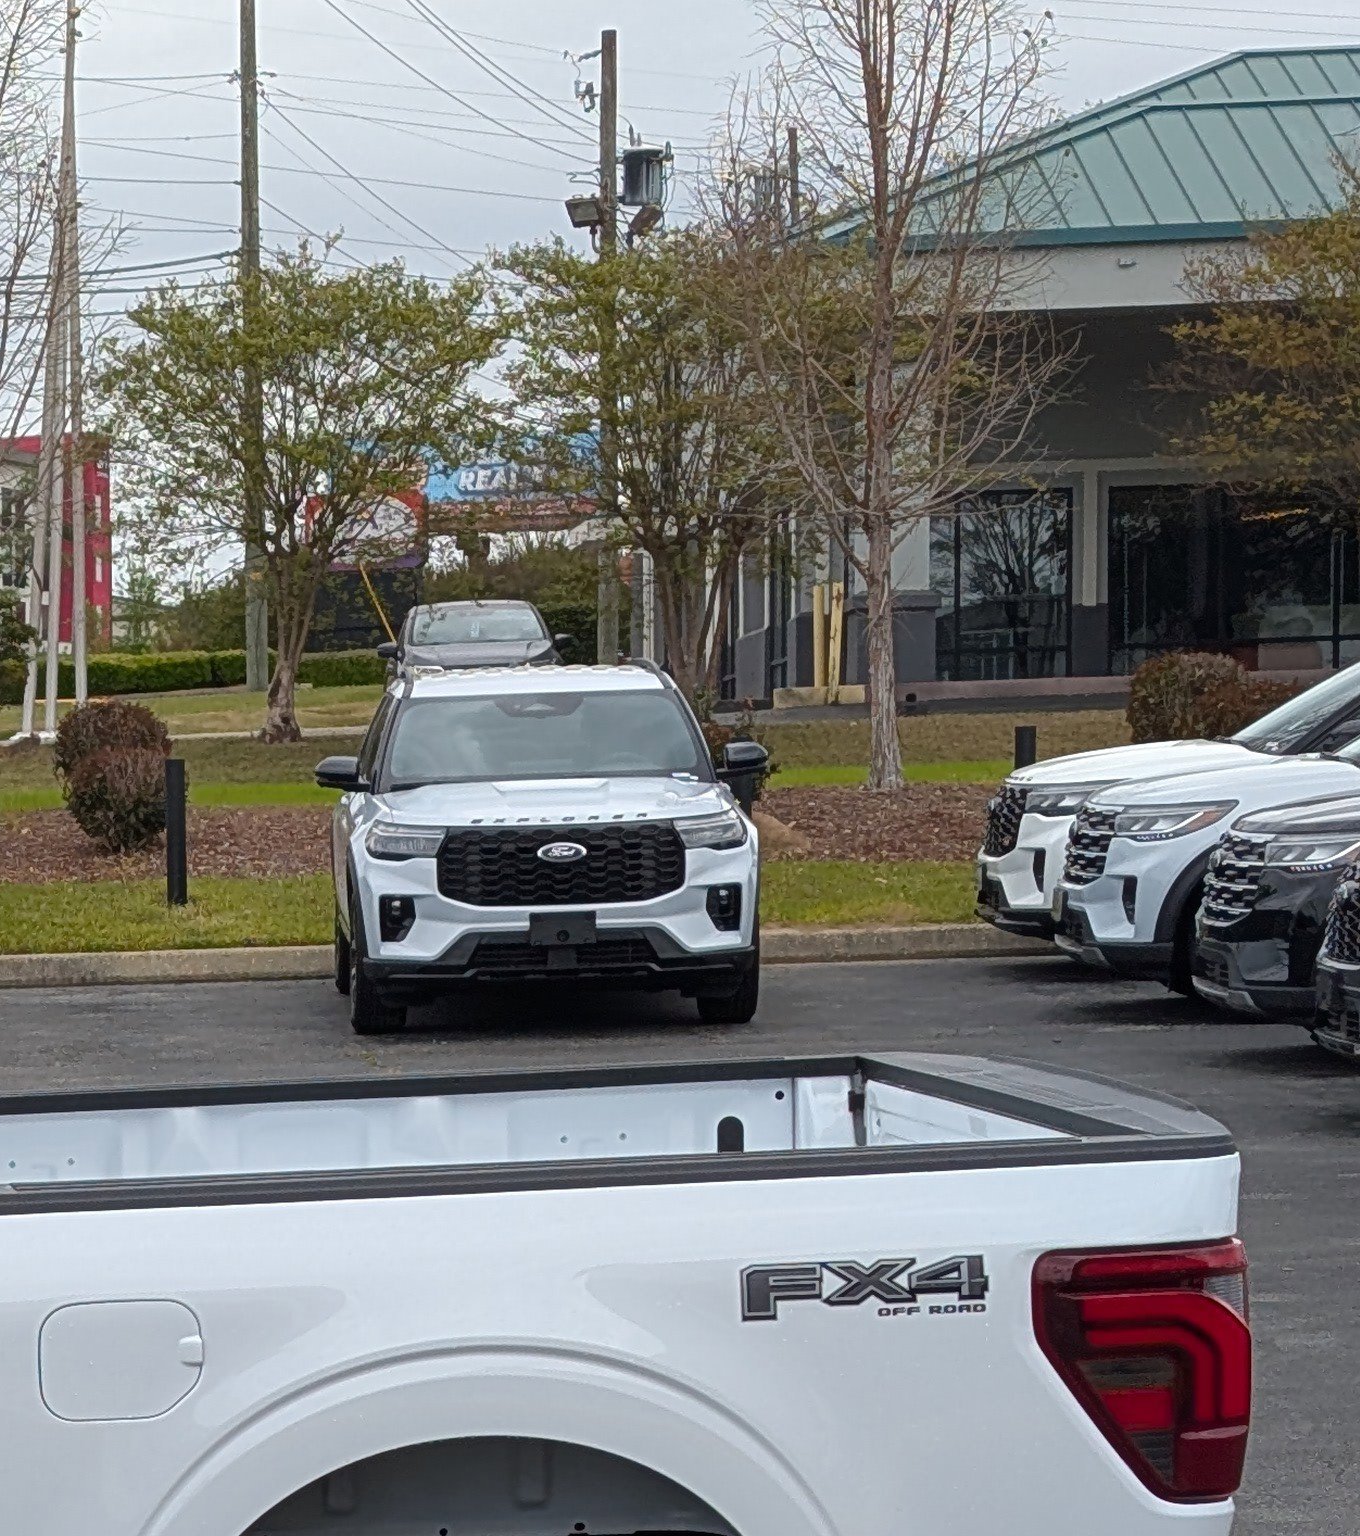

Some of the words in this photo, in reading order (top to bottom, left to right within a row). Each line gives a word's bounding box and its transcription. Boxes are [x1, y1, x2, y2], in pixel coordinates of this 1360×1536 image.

[739, 1254, 989, 1322] FX4
[877, 1305, 921, 1317] OFF
[928, 1303, 987, 1315] ROAD
